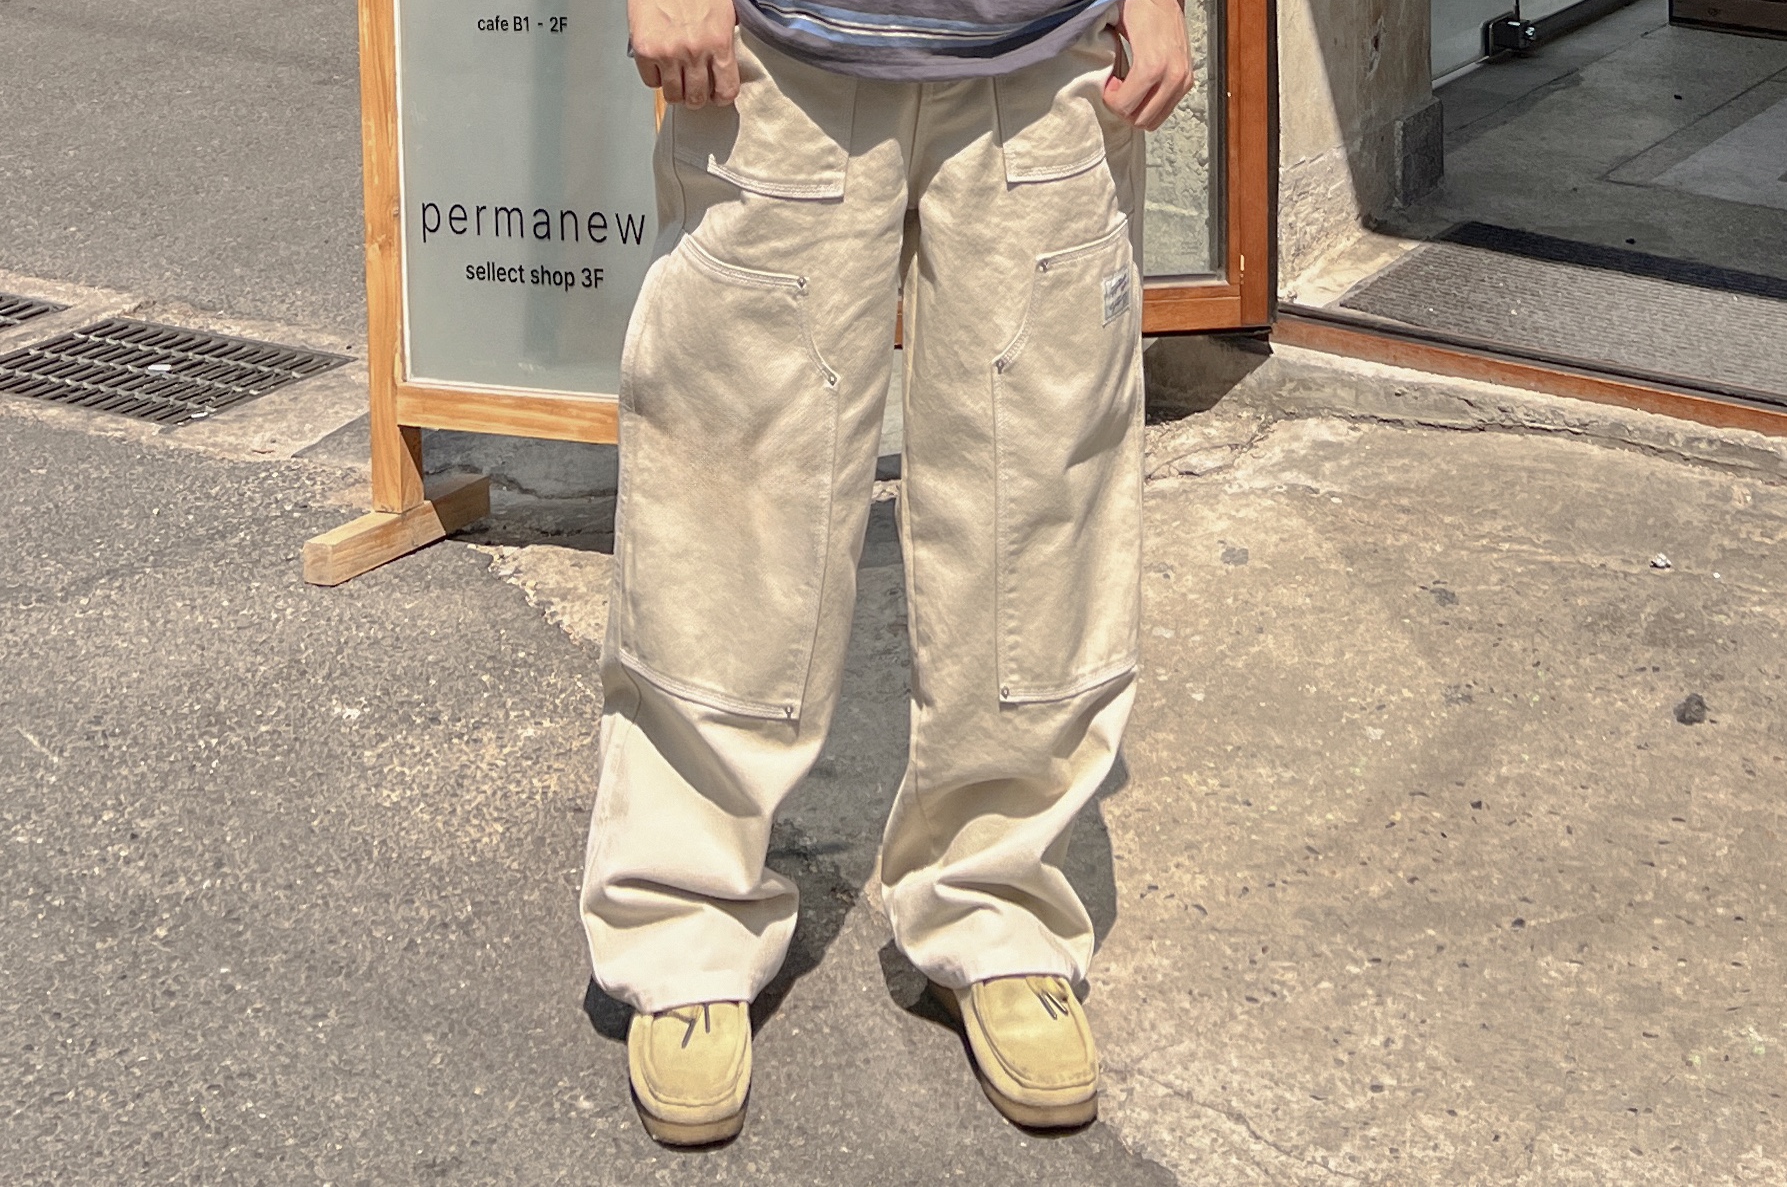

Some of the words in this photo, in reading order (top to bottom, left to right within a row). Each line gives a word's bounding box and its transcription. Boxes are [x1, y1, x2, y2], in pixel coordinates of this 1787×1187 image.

[477, 15, 509, 32] cafe
[513, 16, 530, 32] B1
[549, 16, 568, 33] 2F
[421, 201, 646, 246] permanew
[465, 260, 526, 284] sellect
[530, 264, 575, 292] shop
[581, 267, 604, 289] 3F
